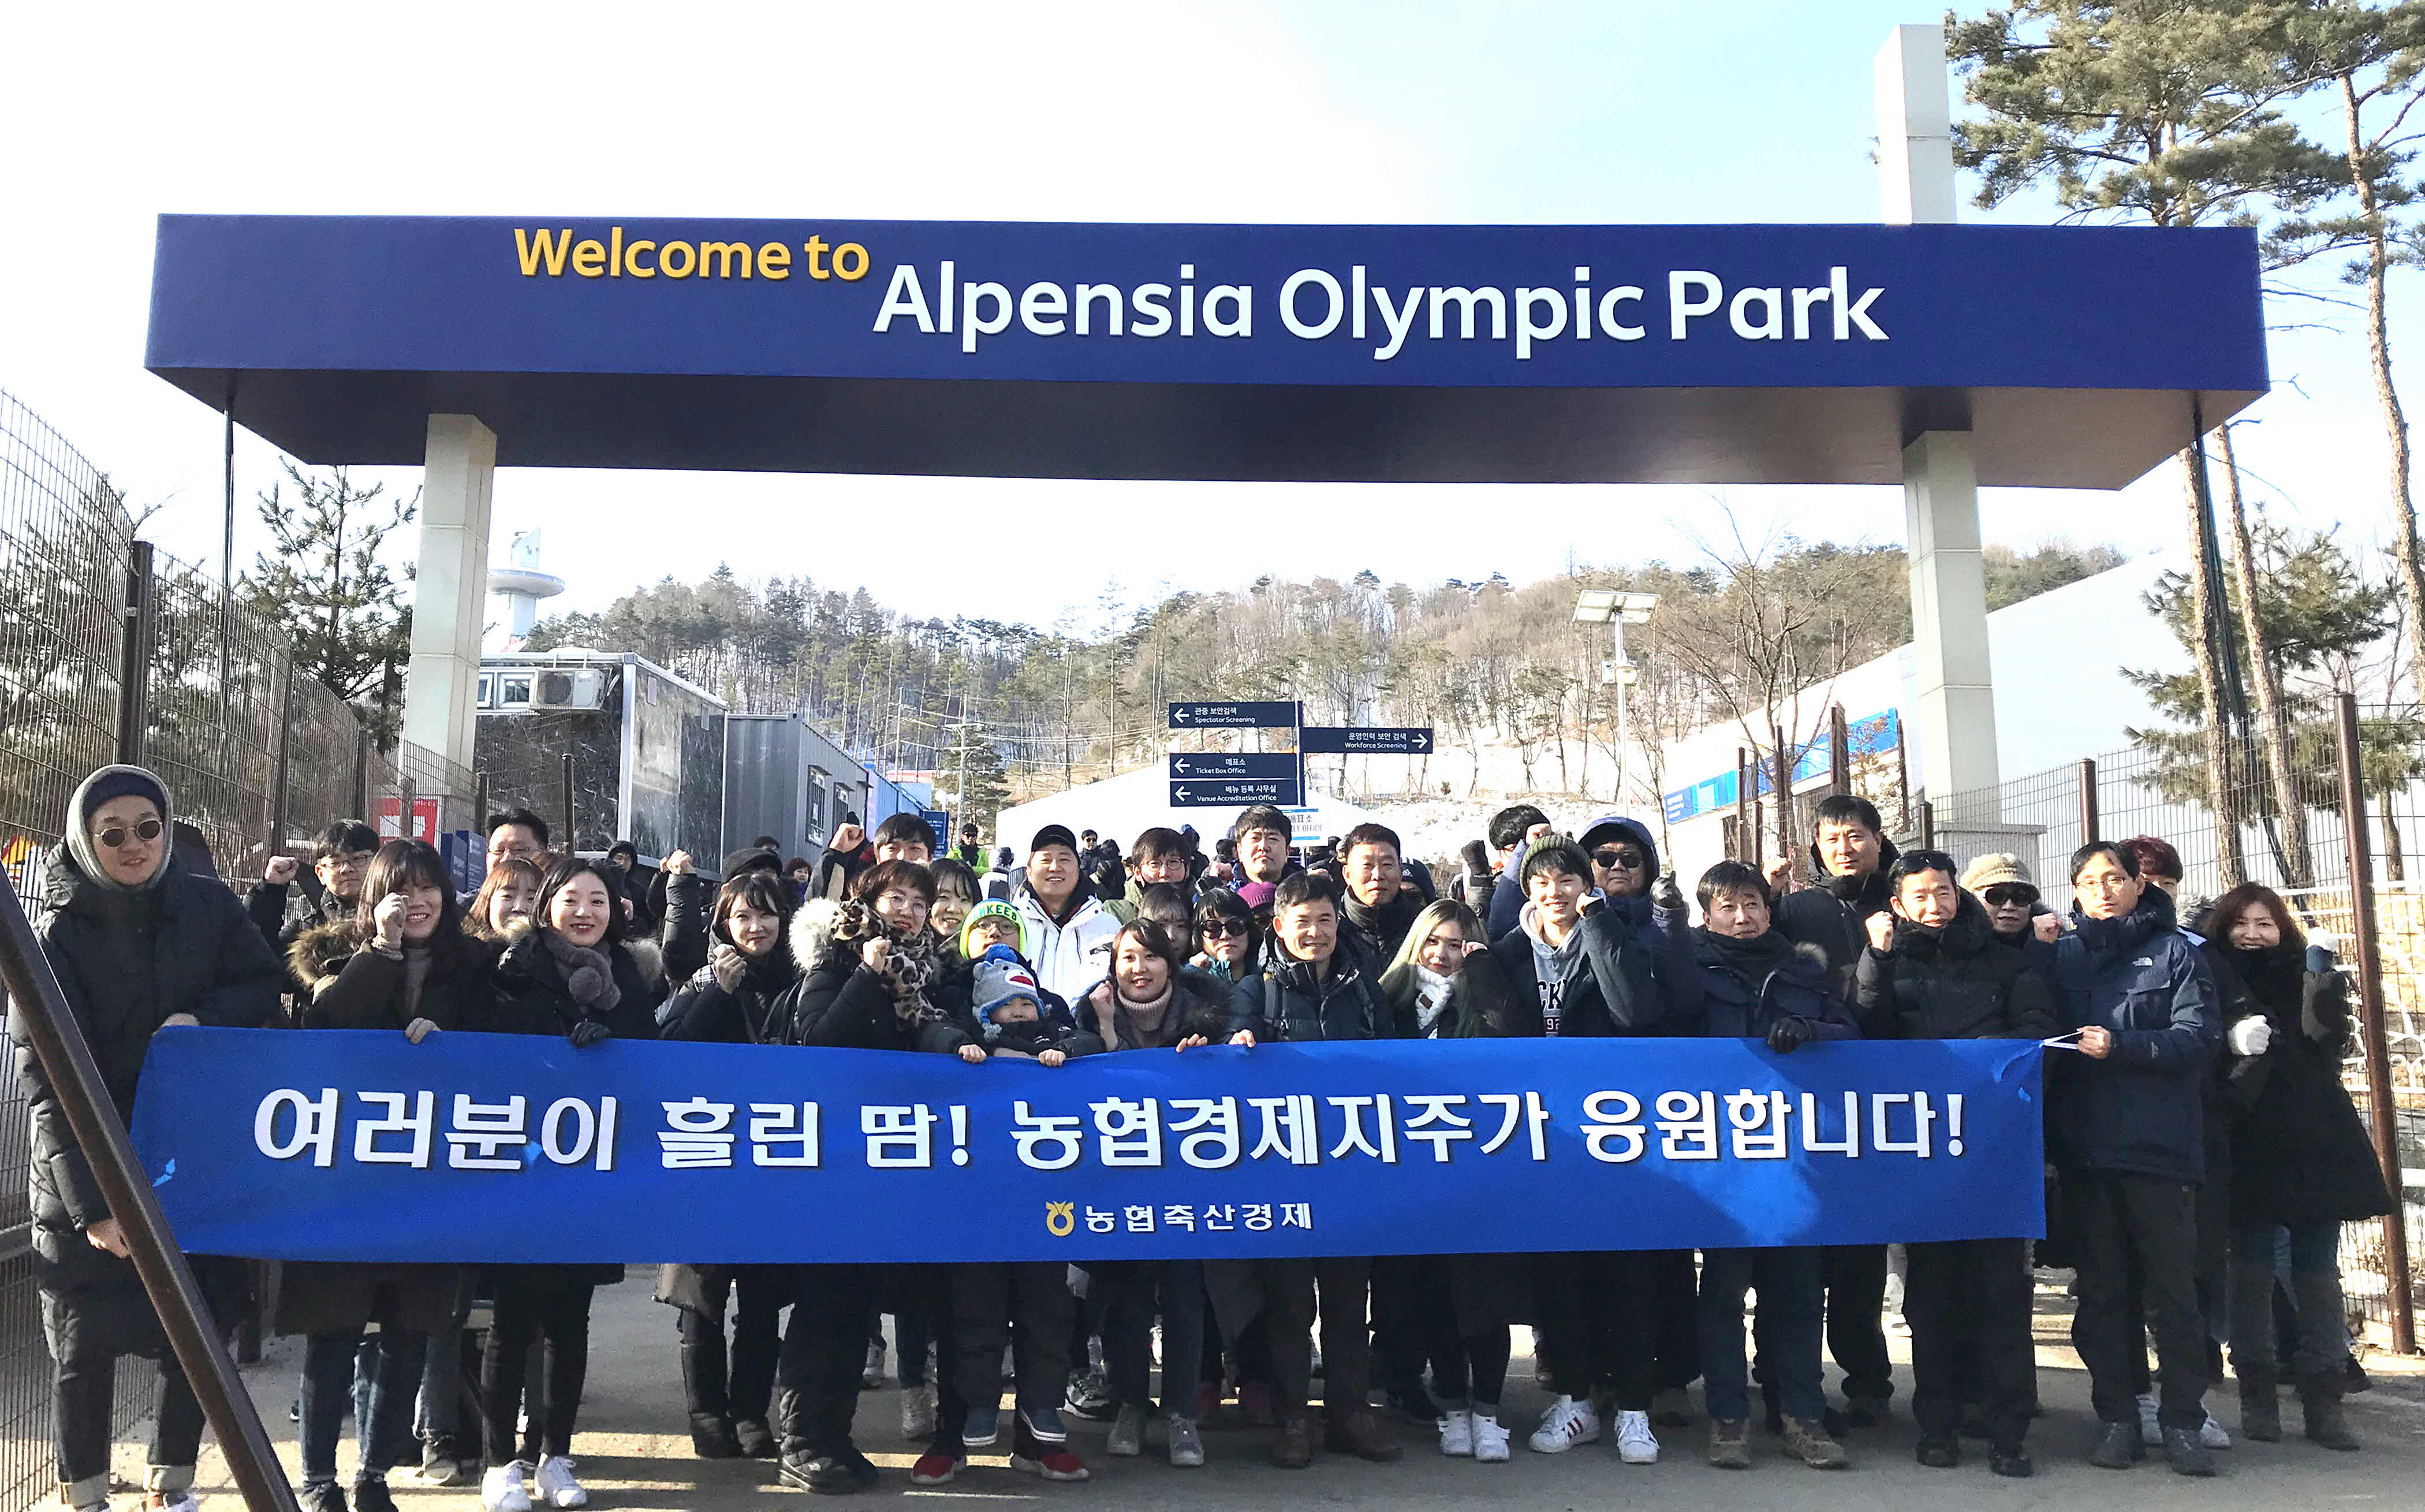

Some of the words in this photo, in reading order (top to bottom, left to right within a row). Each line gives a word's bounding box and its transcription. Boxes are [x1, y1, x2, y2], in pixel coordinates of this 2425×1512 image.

[514, 227, 792, 279] Welcome
[804, 234, 870, 281] to
[872, 260, 1252, 352] Alpensia
[1279, 265, 1646, 360] Olympic
[1669, 266, 1890, 340] Park
[1348, 732, 1375, 741] 운영인력
[1377, 733, 1391, 741] 보안
[1393, 733, 1406, 741] 검색
[1225, 758, 1246, 766] 매표소
[1225, 785, 1240, 794] 베뉴
[1241, 785, 1255, 794] 등록
[1255, 785, 1277, 793] 사무실
[1302, 824, 1322, 832] OFFICE
[254, 1088, 618, 1171] 여러분이
[656, 1096, 819, 1168] 흘린
[860, 1103, 969, 1168] 땀!
[1009, 1091, 1550, 1170] 농협경제지주가
[1579, 1088, 1963, 1162] 응원합니다!
[1085, 1203, 1312, 1233] 농협축산경제
